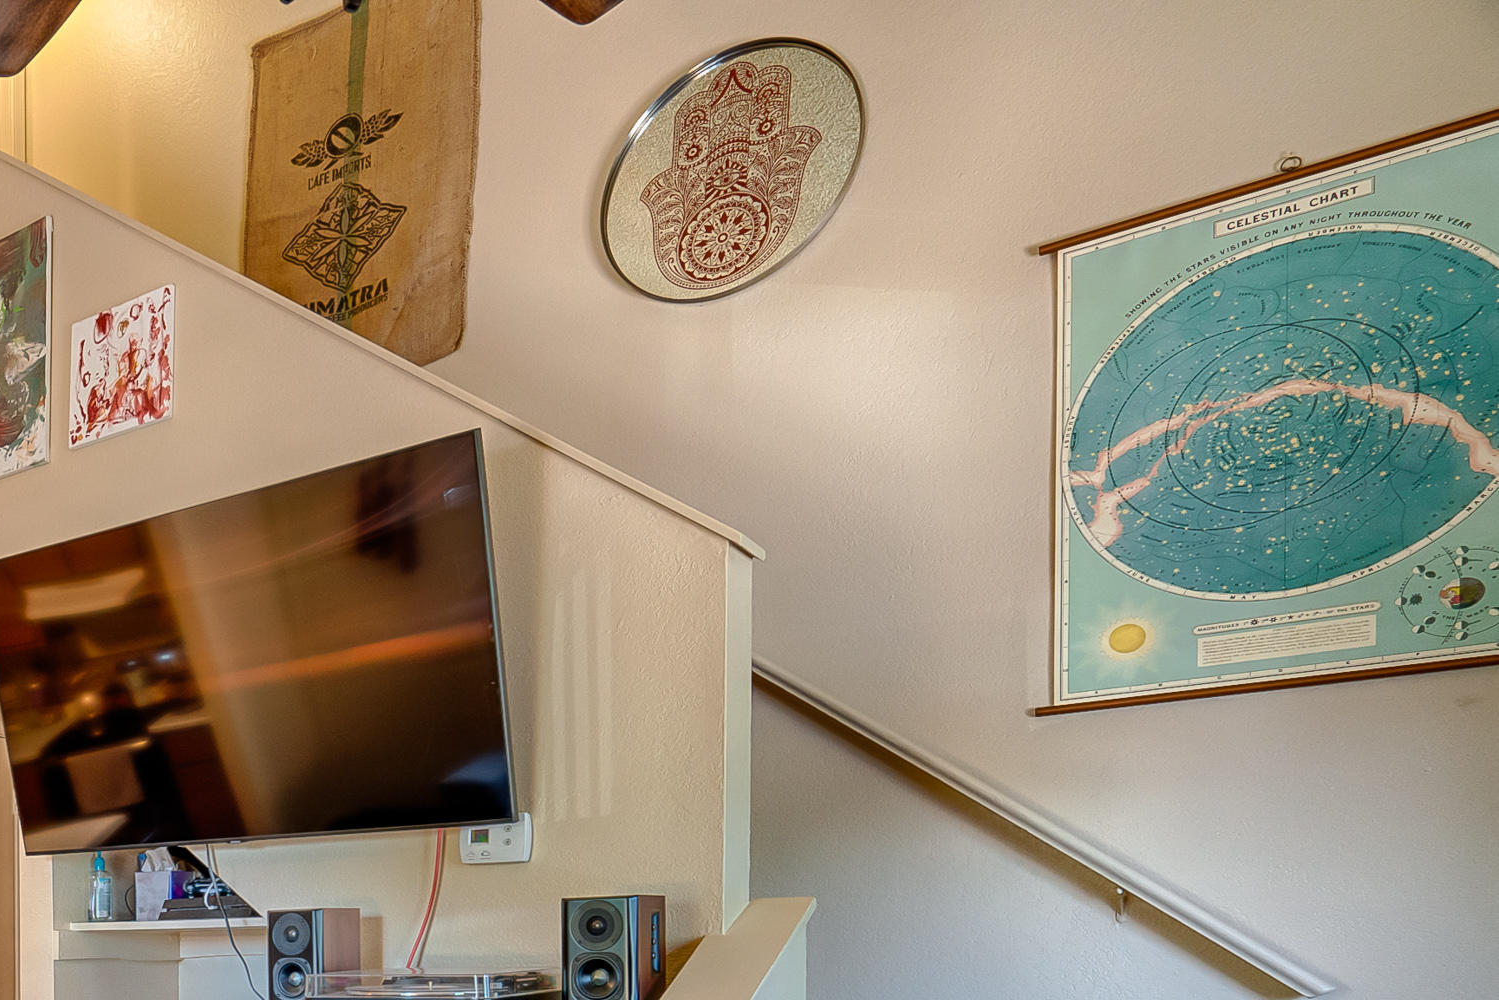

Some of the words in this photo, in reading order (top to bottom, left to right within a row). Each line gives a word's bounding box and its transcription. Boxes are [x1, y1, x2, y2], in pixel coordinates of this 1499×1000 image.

[1227, 203, 1301, 230] CELESTIAL
[1309, 185, 1359, 207] CHART
[1125, 287, 1163, 318] SHOWING
[1164, 273, 1182, 287] THE
[1185, 254, 1217, 272] STARS
[1220, 235, 1260, 255] VISIBLE
[1264, 228, 1279, 237] ON
[1283, 222, 1304, 232] ANY
[1309, 213, 1342, 225] NIGHT
[1348, 210, 1421, 219] THROUGHOUT
[1424, 212, 1443, 222] THE
[1447, 216, 1473, 230] YEAR
[303, 278, 389, 314] UMATRA
